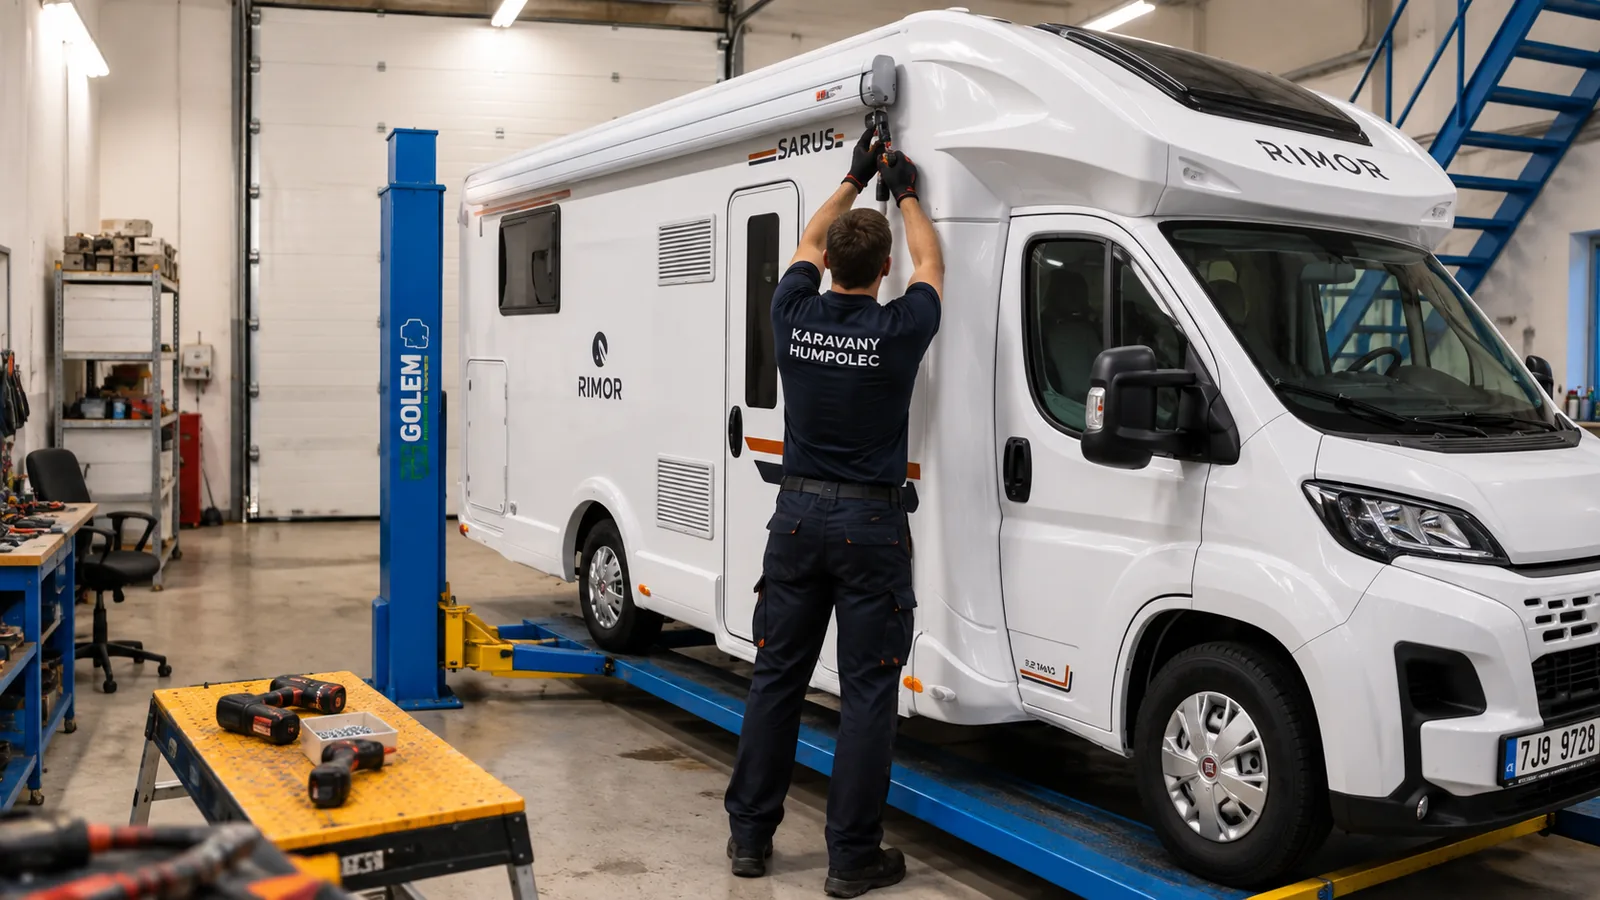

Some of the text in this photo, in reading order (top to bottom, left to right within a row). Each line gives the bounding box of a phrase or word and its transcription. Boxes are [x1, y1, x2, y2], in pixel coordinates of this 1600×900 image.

[778, 128, 835, 160] SARUS
[1255, 139, 1390, 180] RIMOR
[789, 343, 880, 367] HUMPOLEC
[791, 327, 880, 351] KARAVANY
[400, 354, 422, 442] GOLEM
[578, 376, 623, 400] RIMOR
[1521, 723, 1596, 771] 7J9 9728
